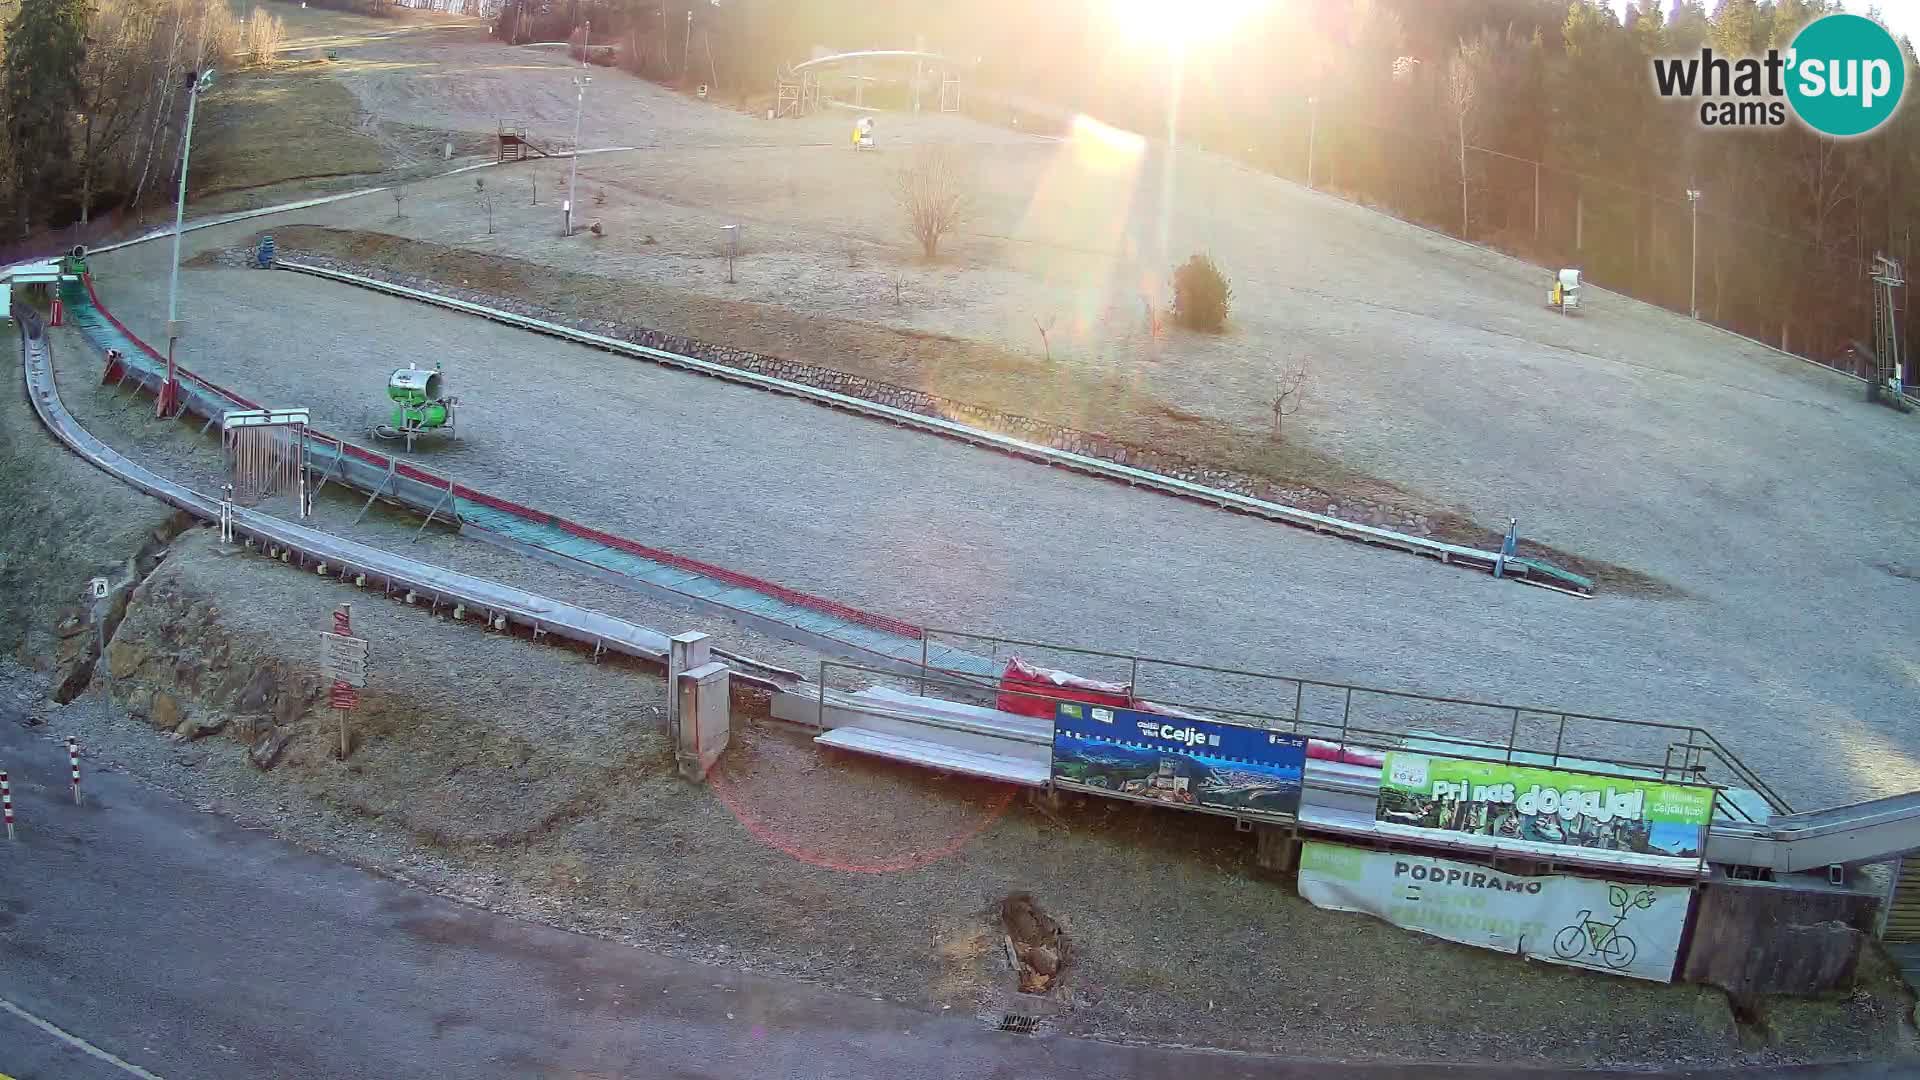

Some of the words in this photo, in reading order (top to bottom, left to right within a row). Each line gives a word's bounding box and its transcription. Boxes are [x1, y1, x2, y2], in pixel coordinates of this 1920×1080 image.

[1160, 725, 1206, 747] Celje
[1431, 779, 1470, 802] Pri
[1473, 783, 1516, 804] nas
[1394, 860, 1543, 896] PODPIRAMO
